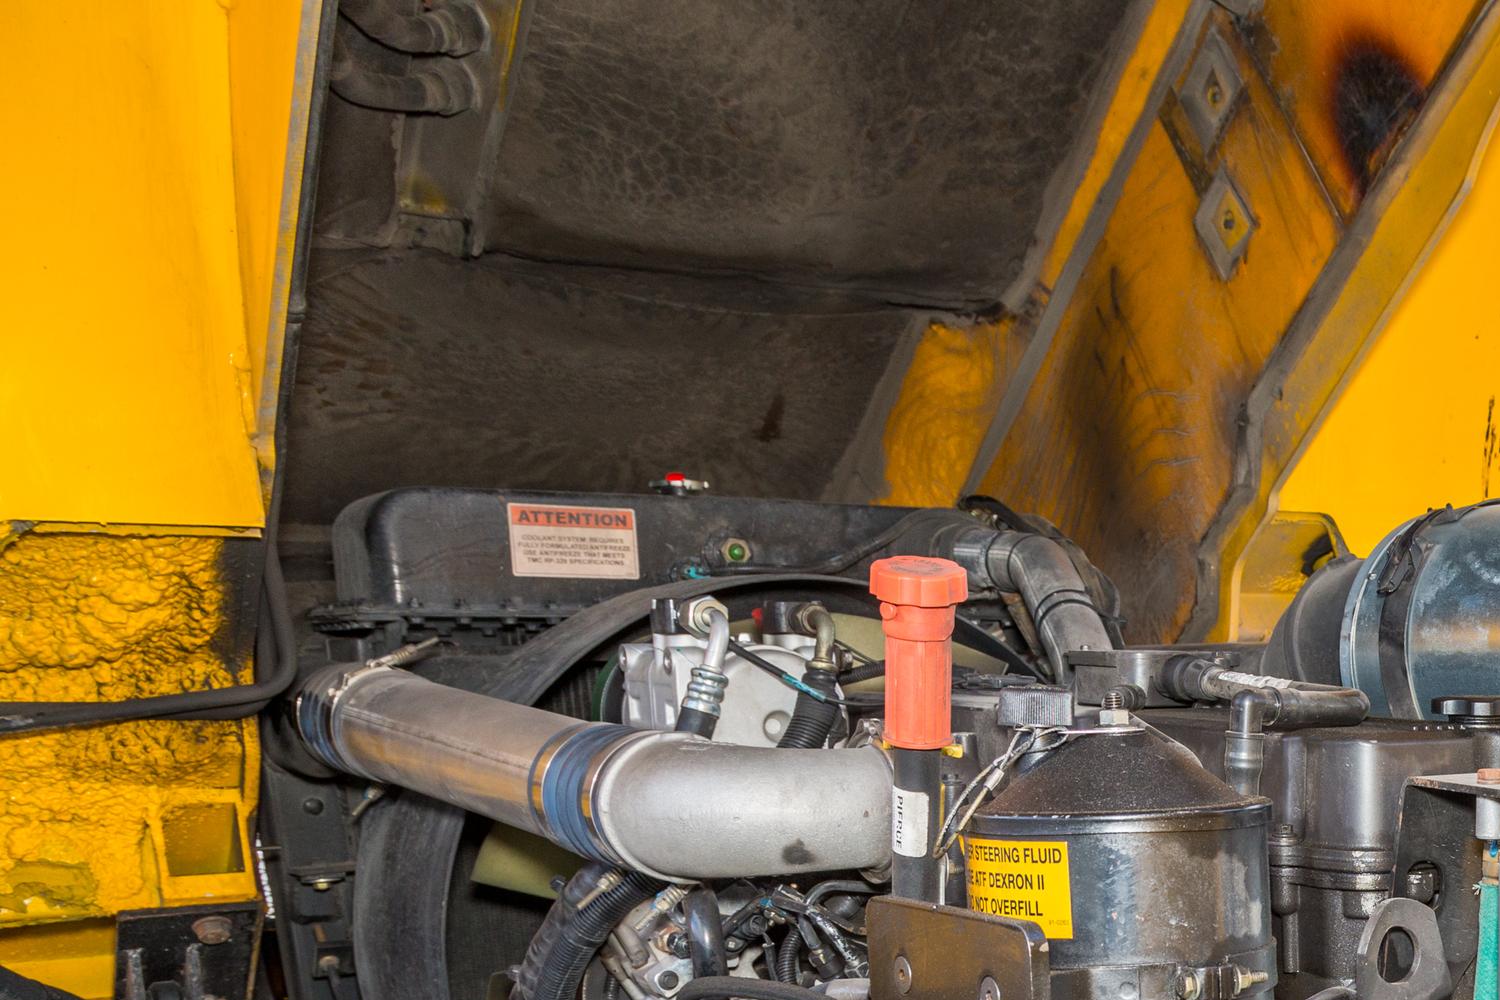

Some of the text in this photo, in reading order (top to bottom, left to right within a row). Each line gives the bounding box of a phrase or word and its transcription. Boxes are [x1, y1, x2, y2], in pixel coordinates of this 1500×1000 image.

[518, 510, 627, 526] ATTENTION
[558, 535, 587, 543] SYSTEM
[590, 544, 630, 552] ANTIFREEZE
[975, 845, 1020, 863] STEERING
[1023, 848, 1062, 864] FLUID
[975, 871, 987, 887] ATF
[989, 872, 1034, 890] DEXRON
[1037, 874, 1045, 890] II
[975, 896, 989, 913] NOT
[991, 898, 1043, 916] OVERFILL
